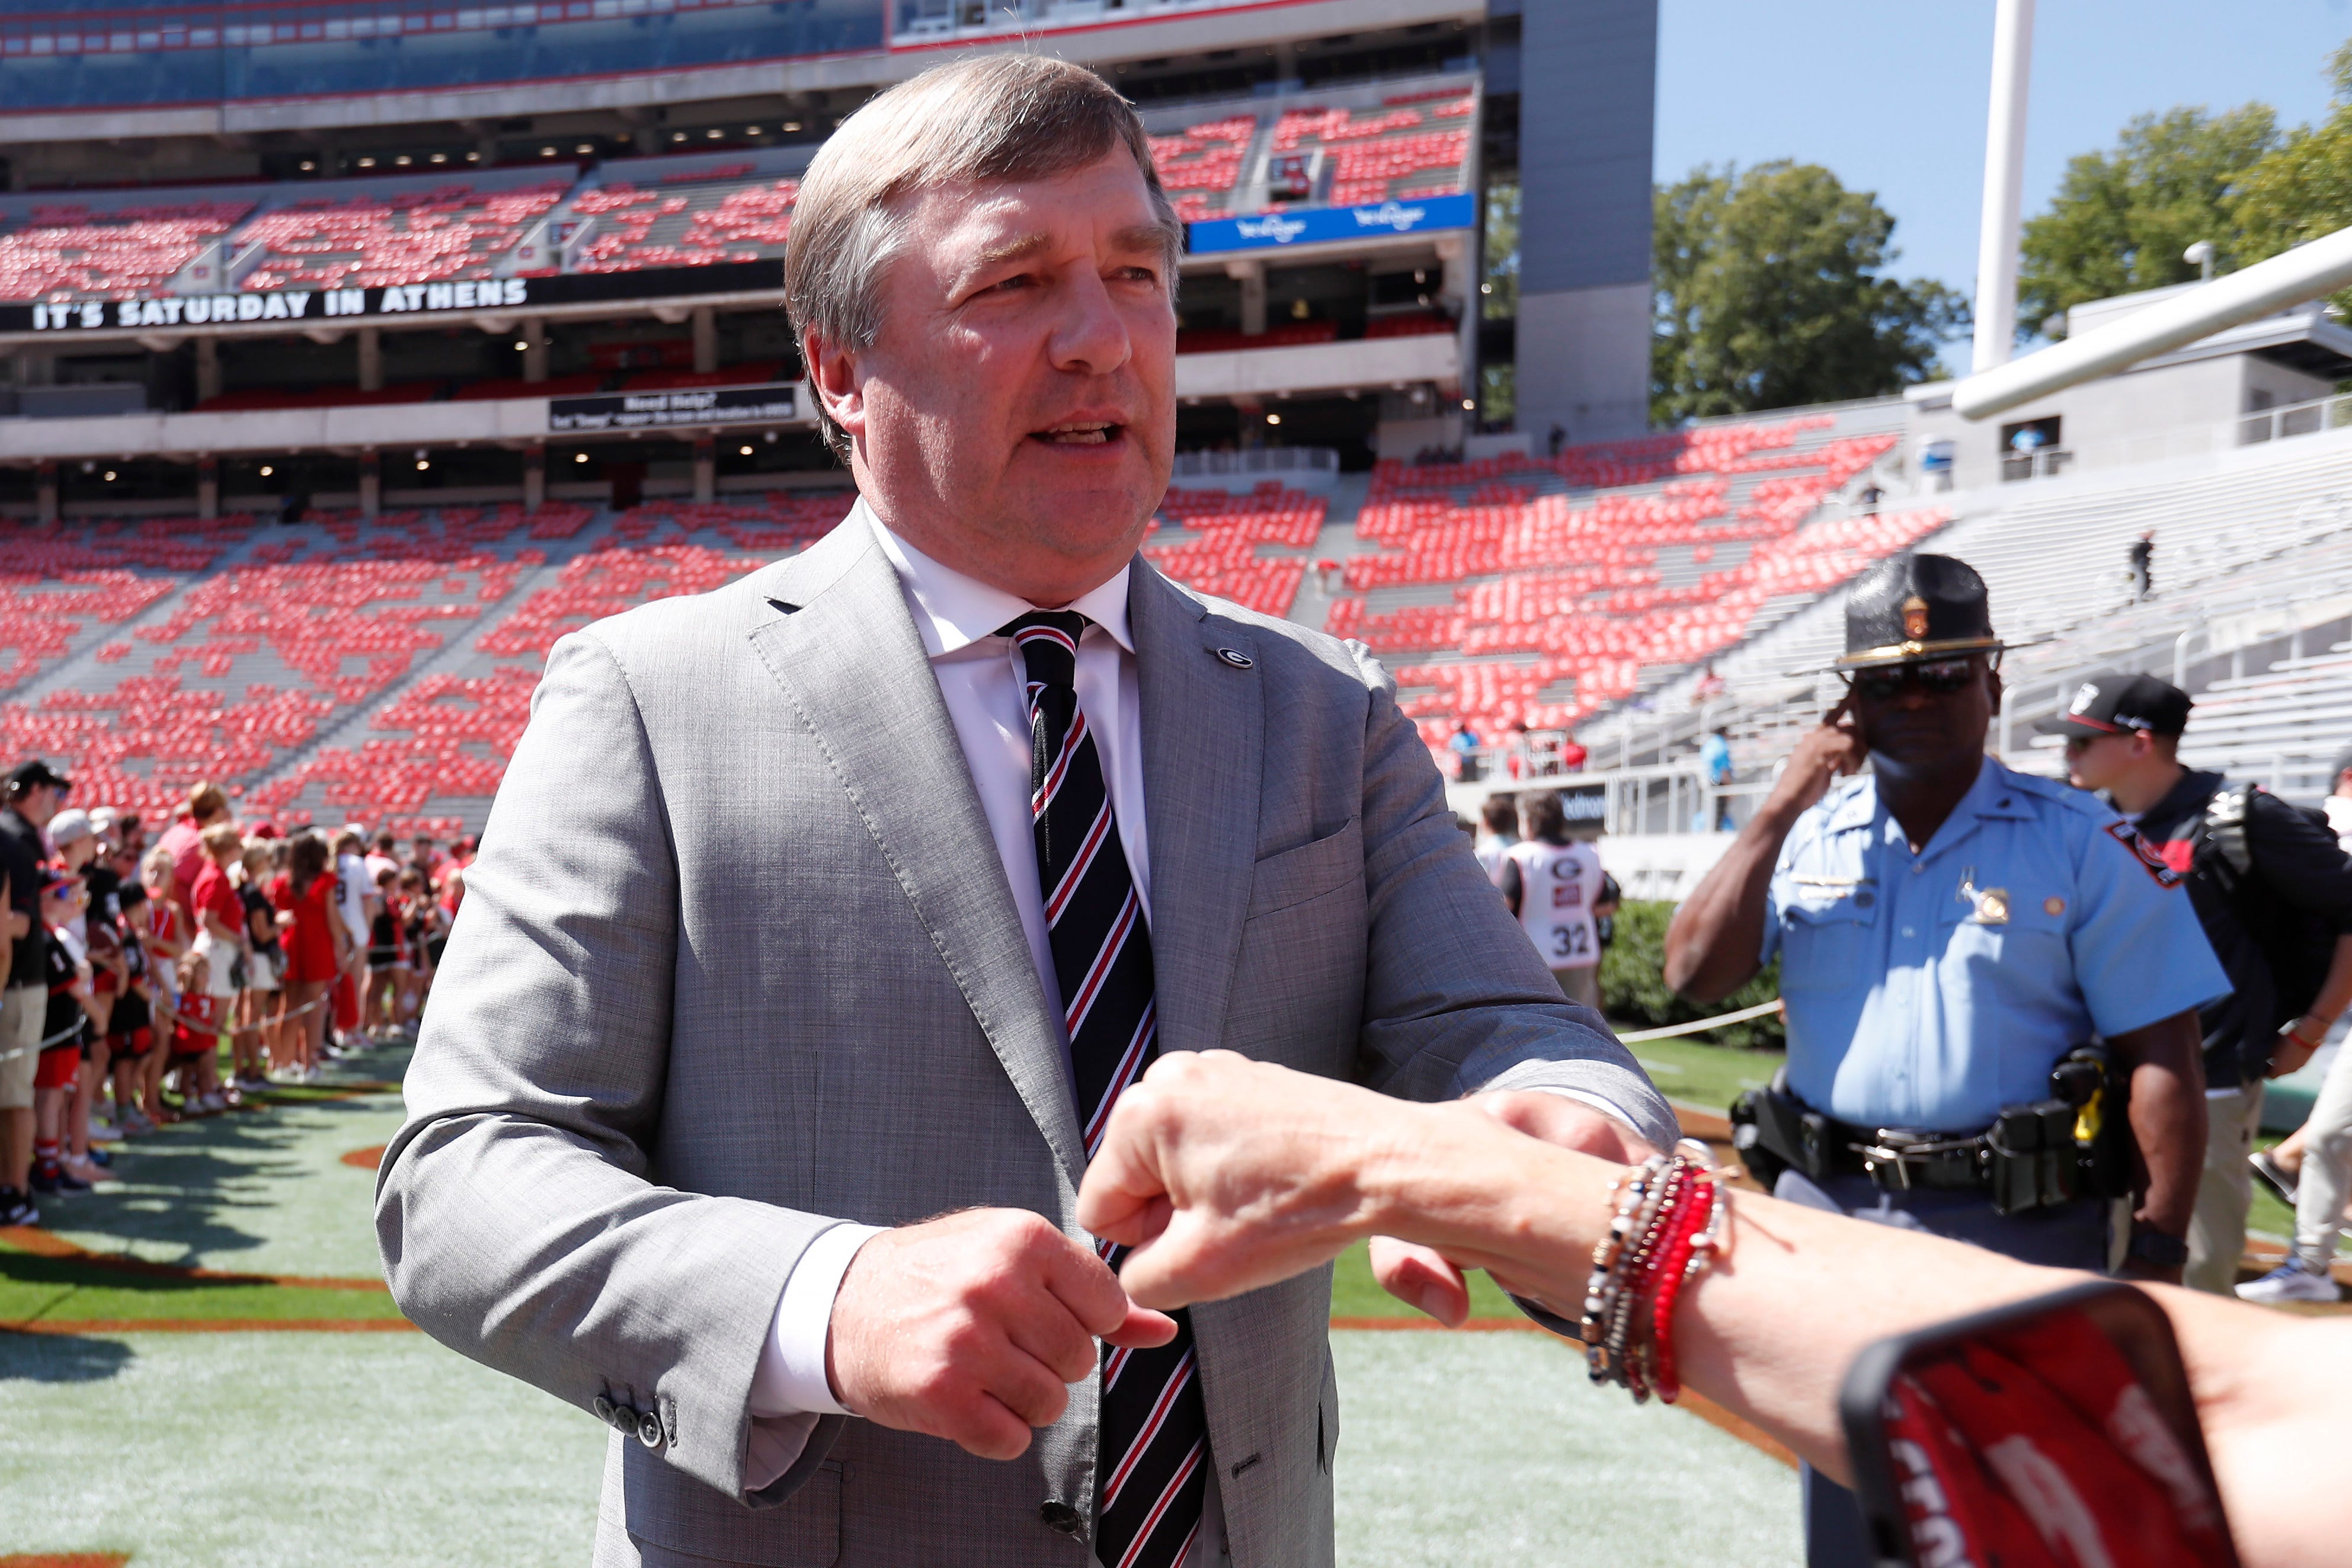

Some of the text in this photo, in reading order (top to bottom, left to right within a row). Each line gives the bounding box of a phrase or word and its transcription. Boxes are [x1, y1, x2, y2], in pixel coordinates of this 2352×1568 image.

[33, 279, 528, 331] IT'S SATURDAY IN ATHENS
[1217, 648, 1253, 667] G
[1552, 923, 1589, 957] 32
